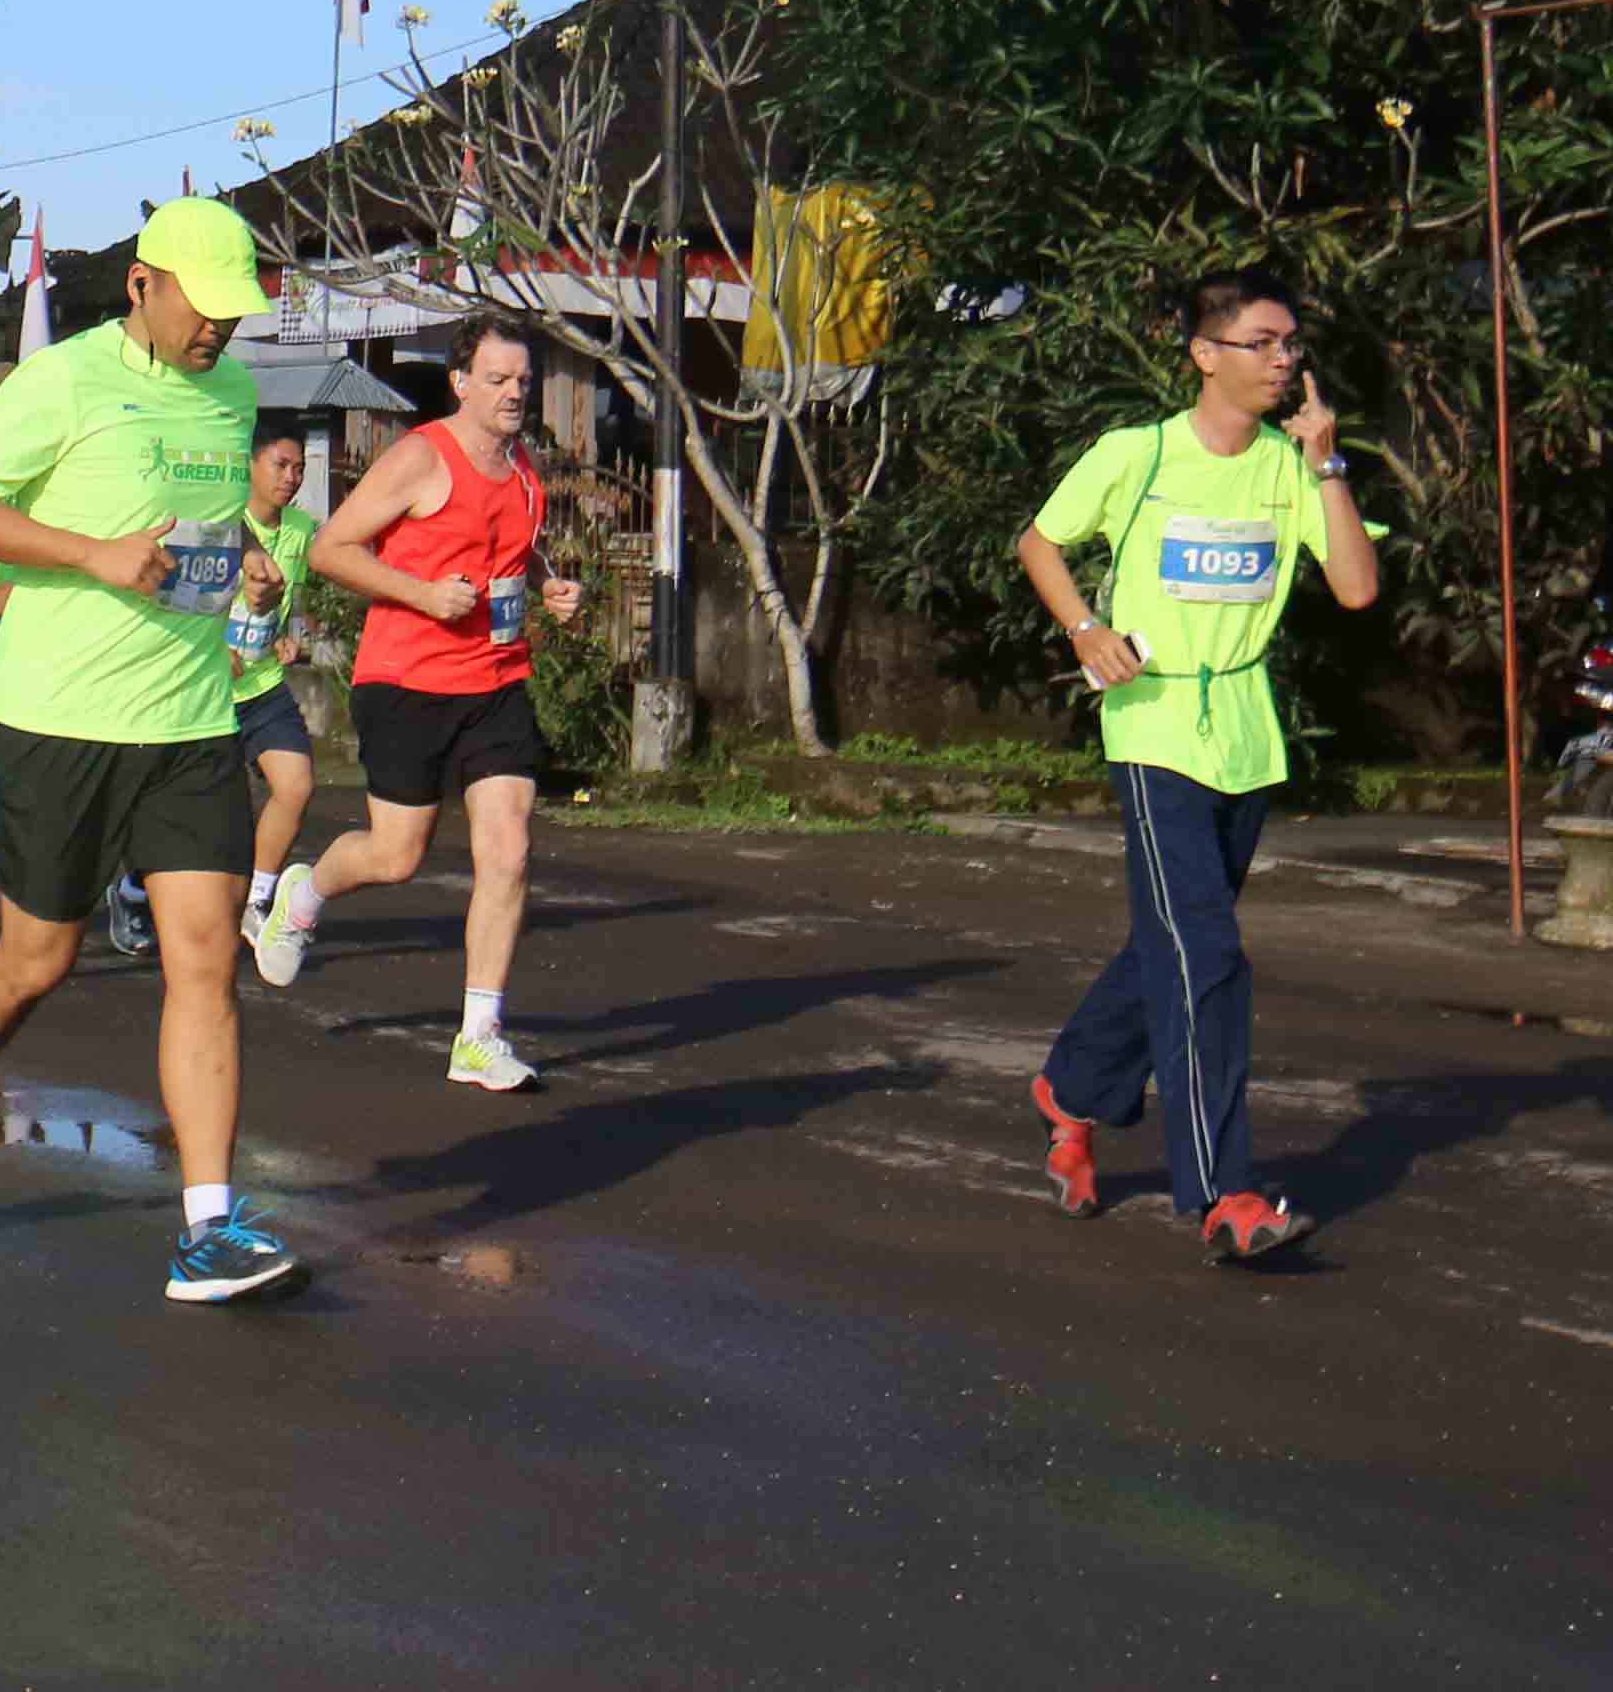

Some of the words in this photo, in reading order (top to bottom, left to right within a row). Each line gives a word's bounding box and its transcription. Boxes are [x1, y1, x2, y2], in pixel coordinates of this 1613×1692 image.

[173, 462, 227, 482] GREEN
[230, 466, 249, 483] RU
[179, 554, 230, 584] 1089
[1181, 548, 1260, 577] 1093
